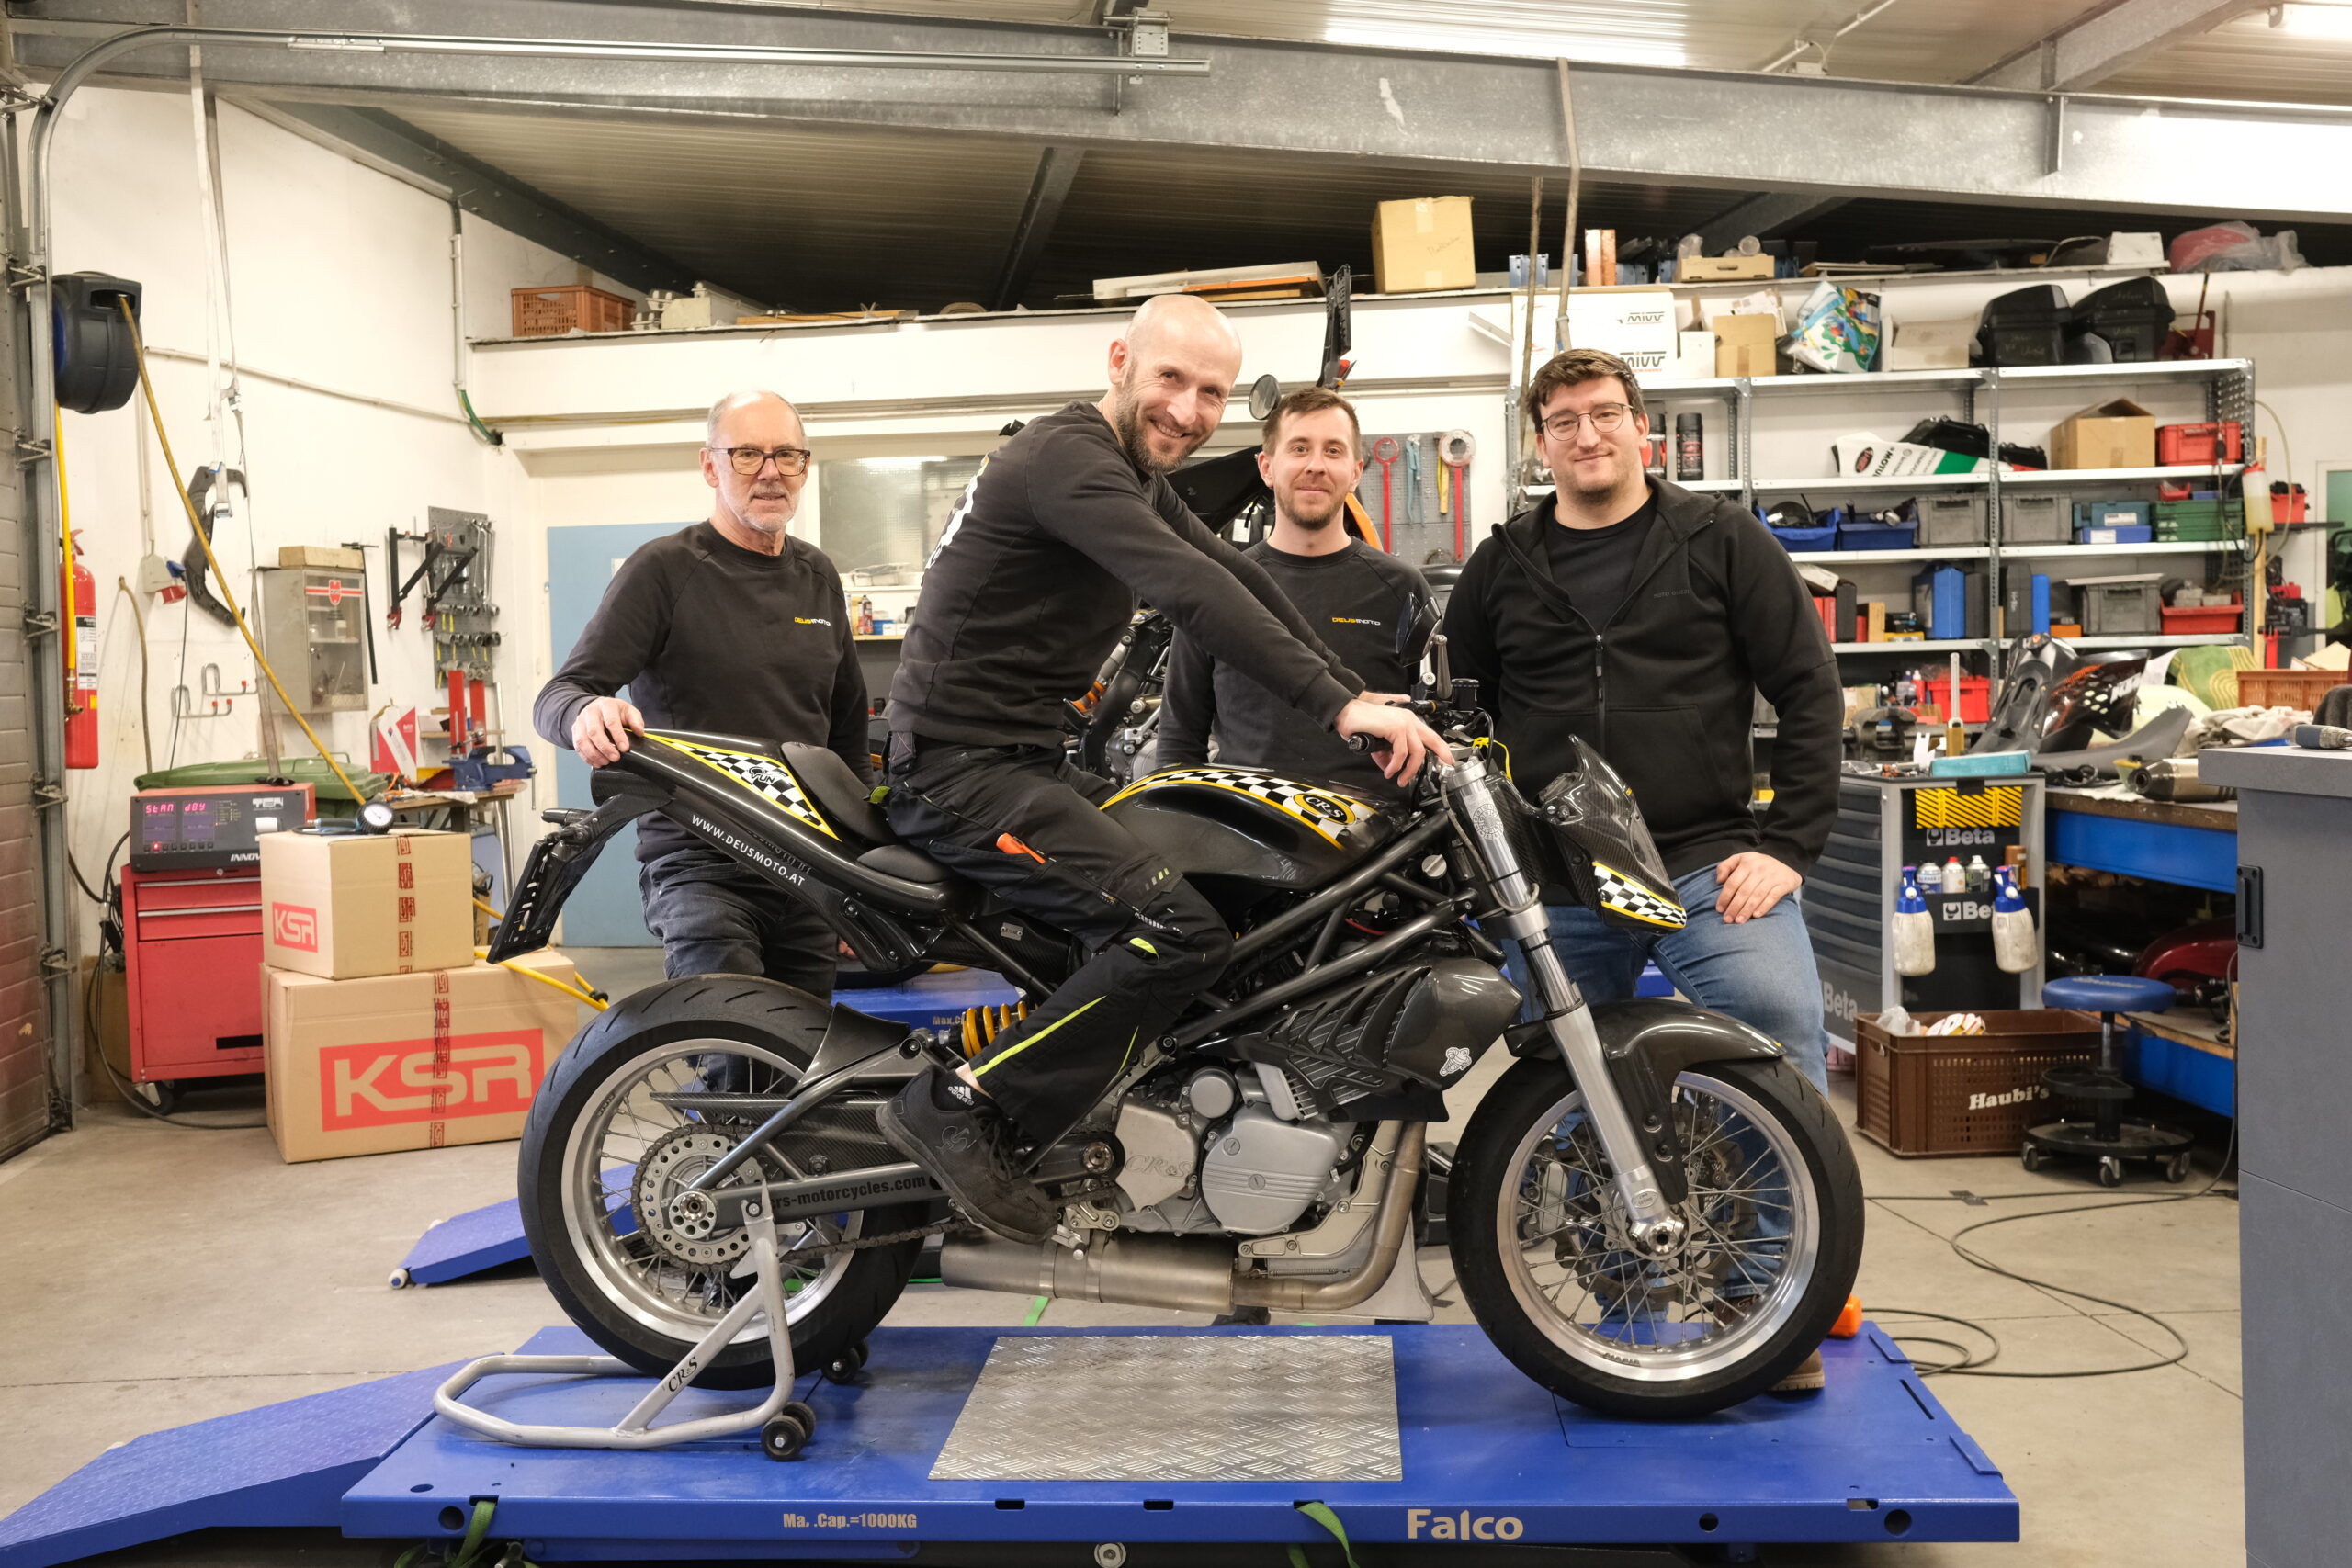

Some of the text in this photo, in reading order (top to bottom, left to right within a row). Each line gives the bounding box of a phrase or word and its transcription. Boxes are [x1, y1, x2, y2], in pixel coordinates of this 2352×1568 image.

[692, 814, 806, 886] WWW.DEUSMOTO.AT
[1945, 828, 1996, 846] Beta
[1962, 901, 1996, 919] Be
[274, 908, 316, 947] KSR
[1823, 981, 1858, 1022] Beta
[334, 1043, 532, 1118] KSR
[947, 1086, 975, 1106] adidas
[1968, 1085, 2050, 1111] Haubi's
[1408, 1508, 1524, 1541] Falco
